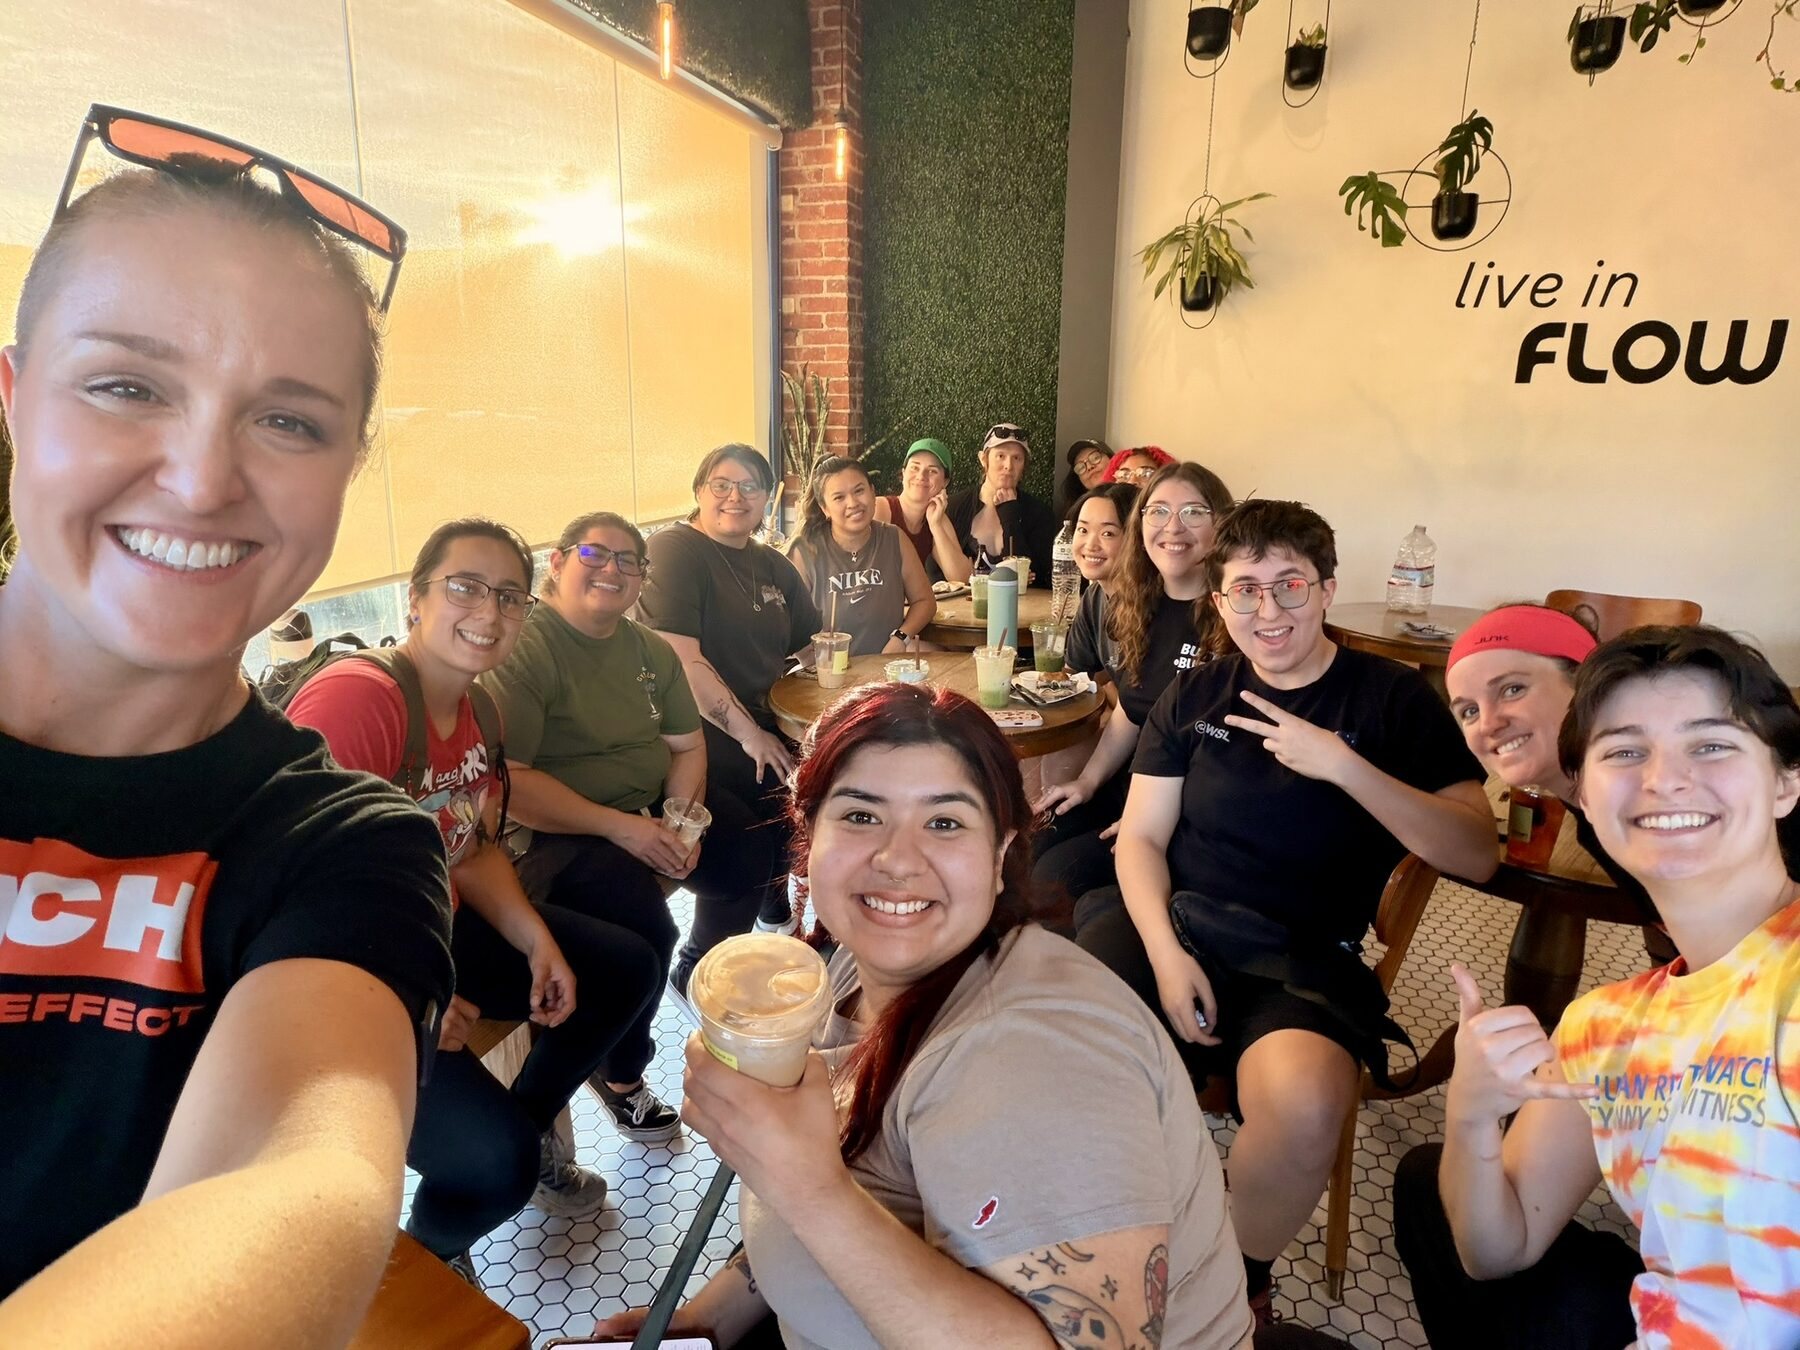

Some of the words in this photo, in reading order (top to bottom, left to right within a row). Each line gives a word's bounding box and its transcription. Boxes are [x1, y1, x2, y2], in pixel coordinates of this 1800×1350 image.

[1455, 260, 1564, 308] live
[1581, 259, 1639, 308] in
[1514, 319, 1790, 385] FLOW
[828, 568, 884, 594] NIKE
